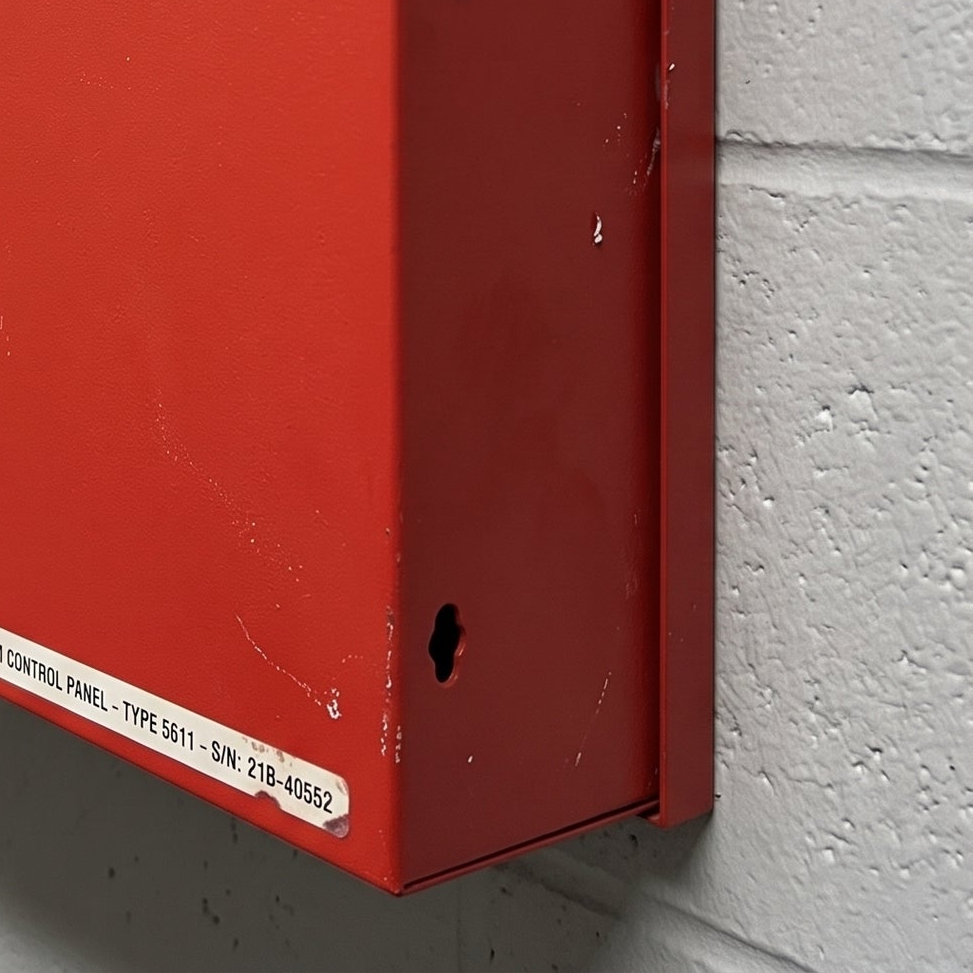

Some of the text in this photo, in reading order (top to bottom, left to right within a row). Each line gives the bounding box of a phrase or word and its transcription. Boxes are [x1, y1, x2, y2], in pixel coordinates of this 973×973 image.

[7, 649, 63, 691] CONTROL
[66, 680, 108, 712] PANEL
[122, 701, 158, 734] TYPE
[161, 718, 194, 751] 5611
[211, 741, 241, 772] S/N:
[247, 757, 333, 814] 21B-40552
